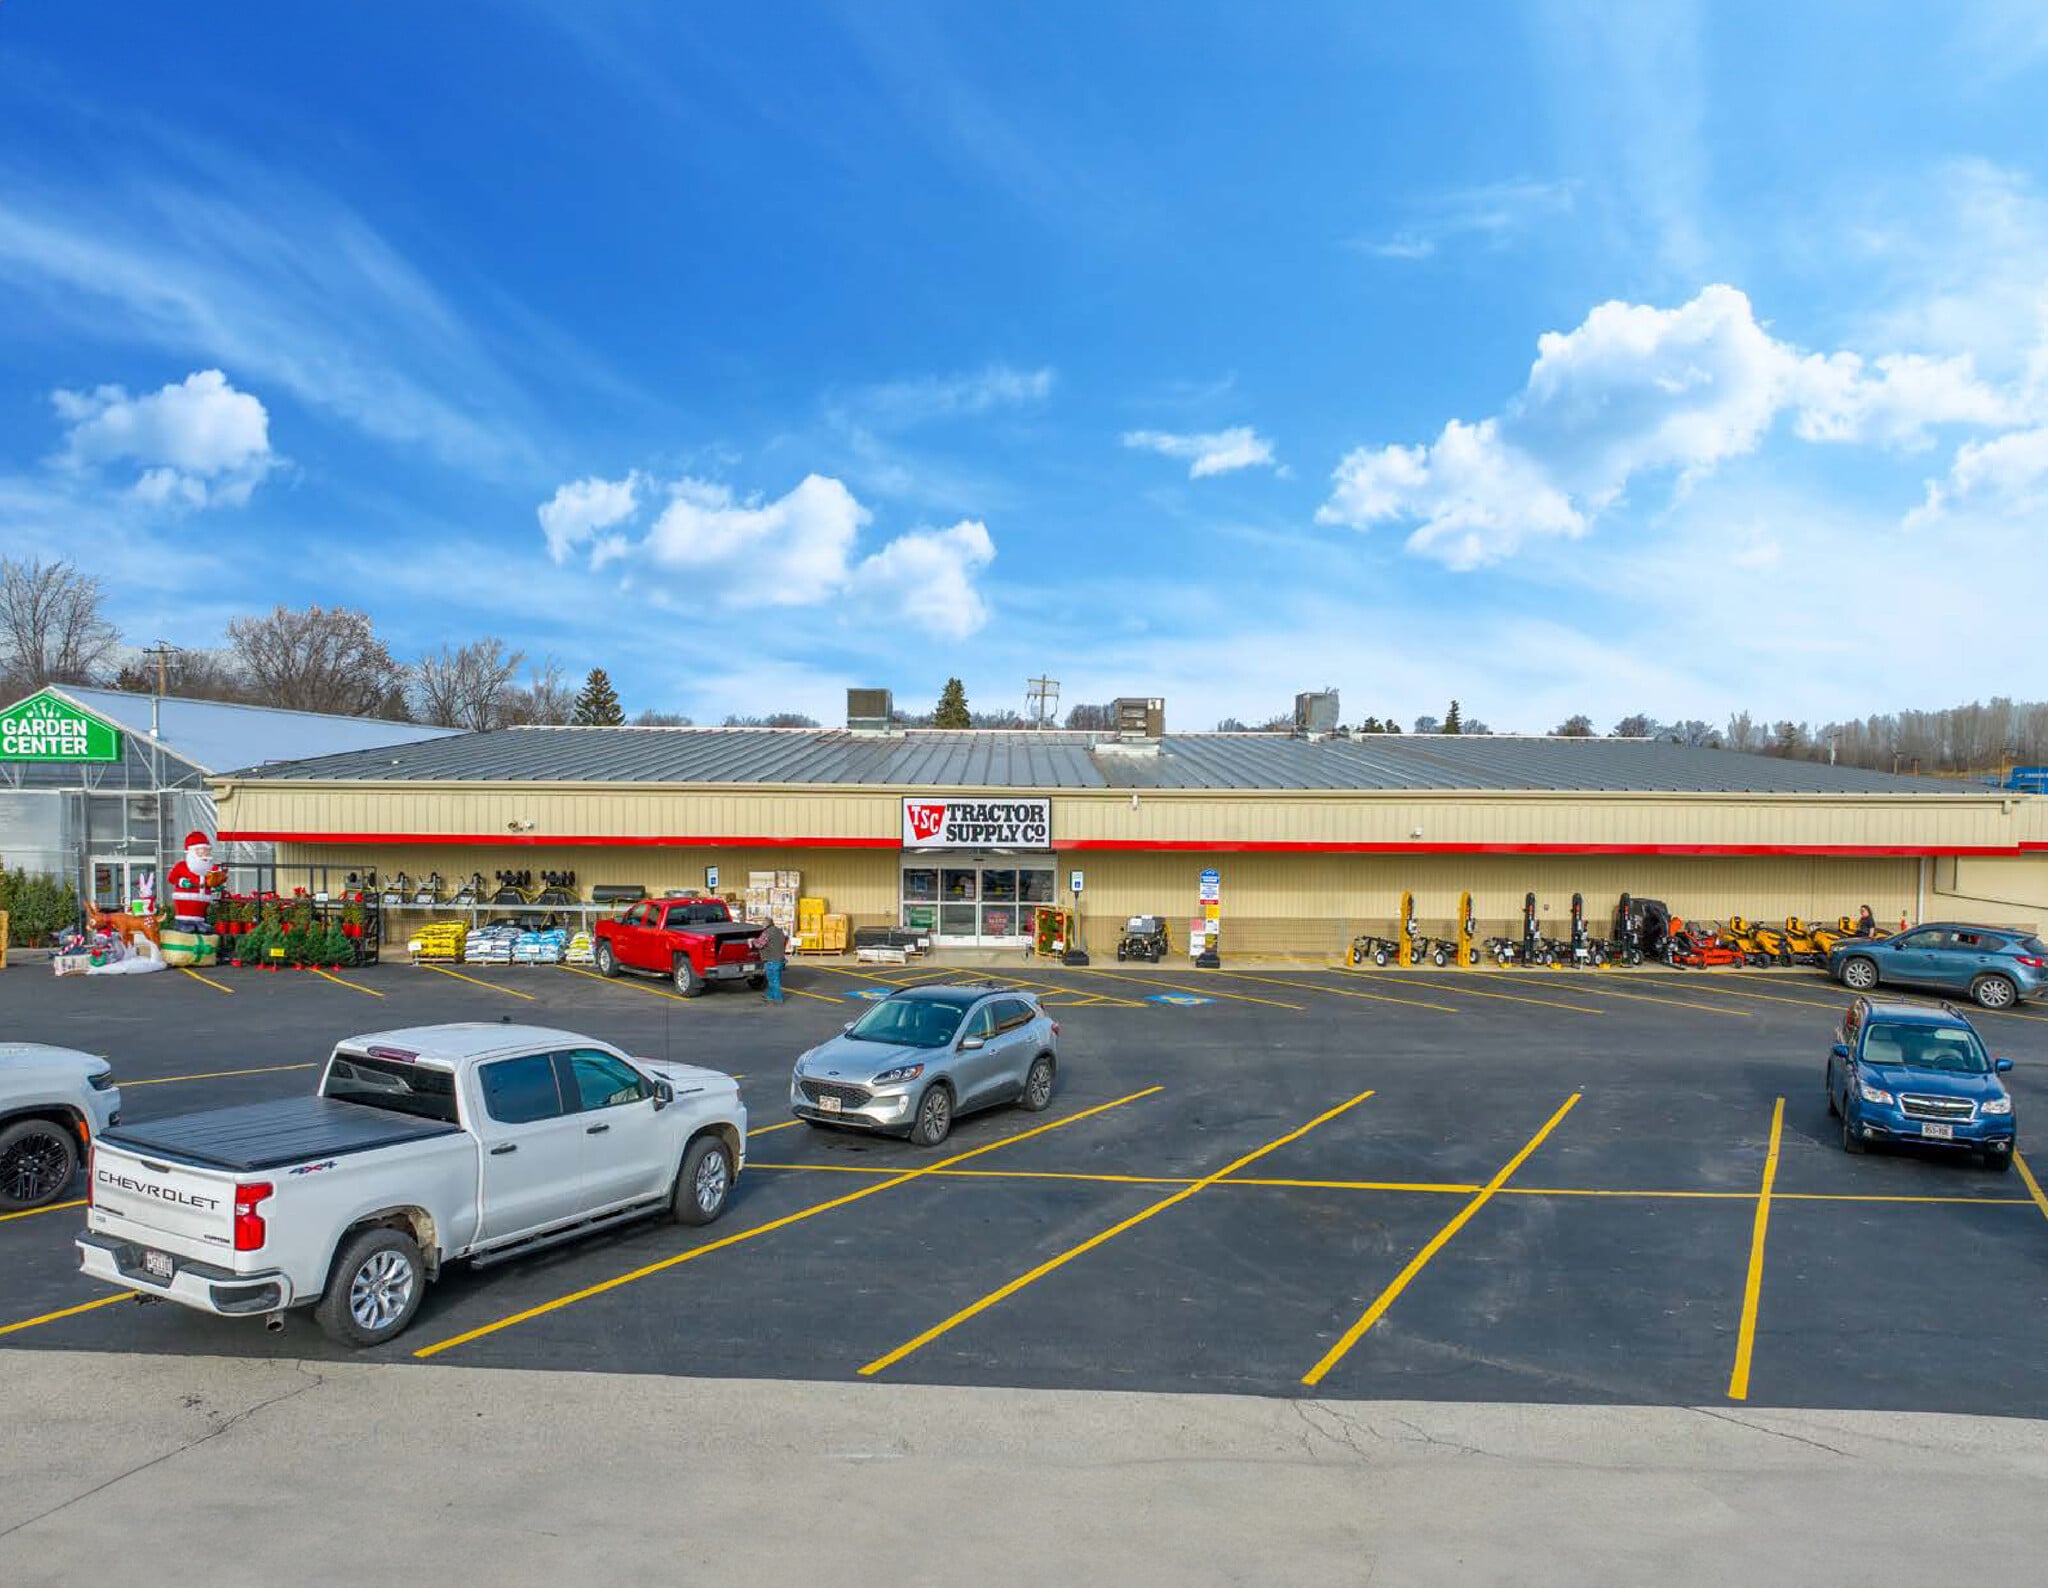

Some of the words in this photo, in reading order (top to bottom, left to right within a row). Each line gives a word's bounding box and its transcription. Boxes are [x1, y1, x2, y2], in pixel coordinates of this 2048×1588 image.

[2, 718, 87, 736] GARDEN
[2, 736, 88, 754] CENTER
[911, 805, 940, 833] TSC
[946, 803, 1045, 823] TRACTOR
[946, 824, 1020, 842] SUPPLY
[98, 1170, 220, 1210] CHEVROLET
